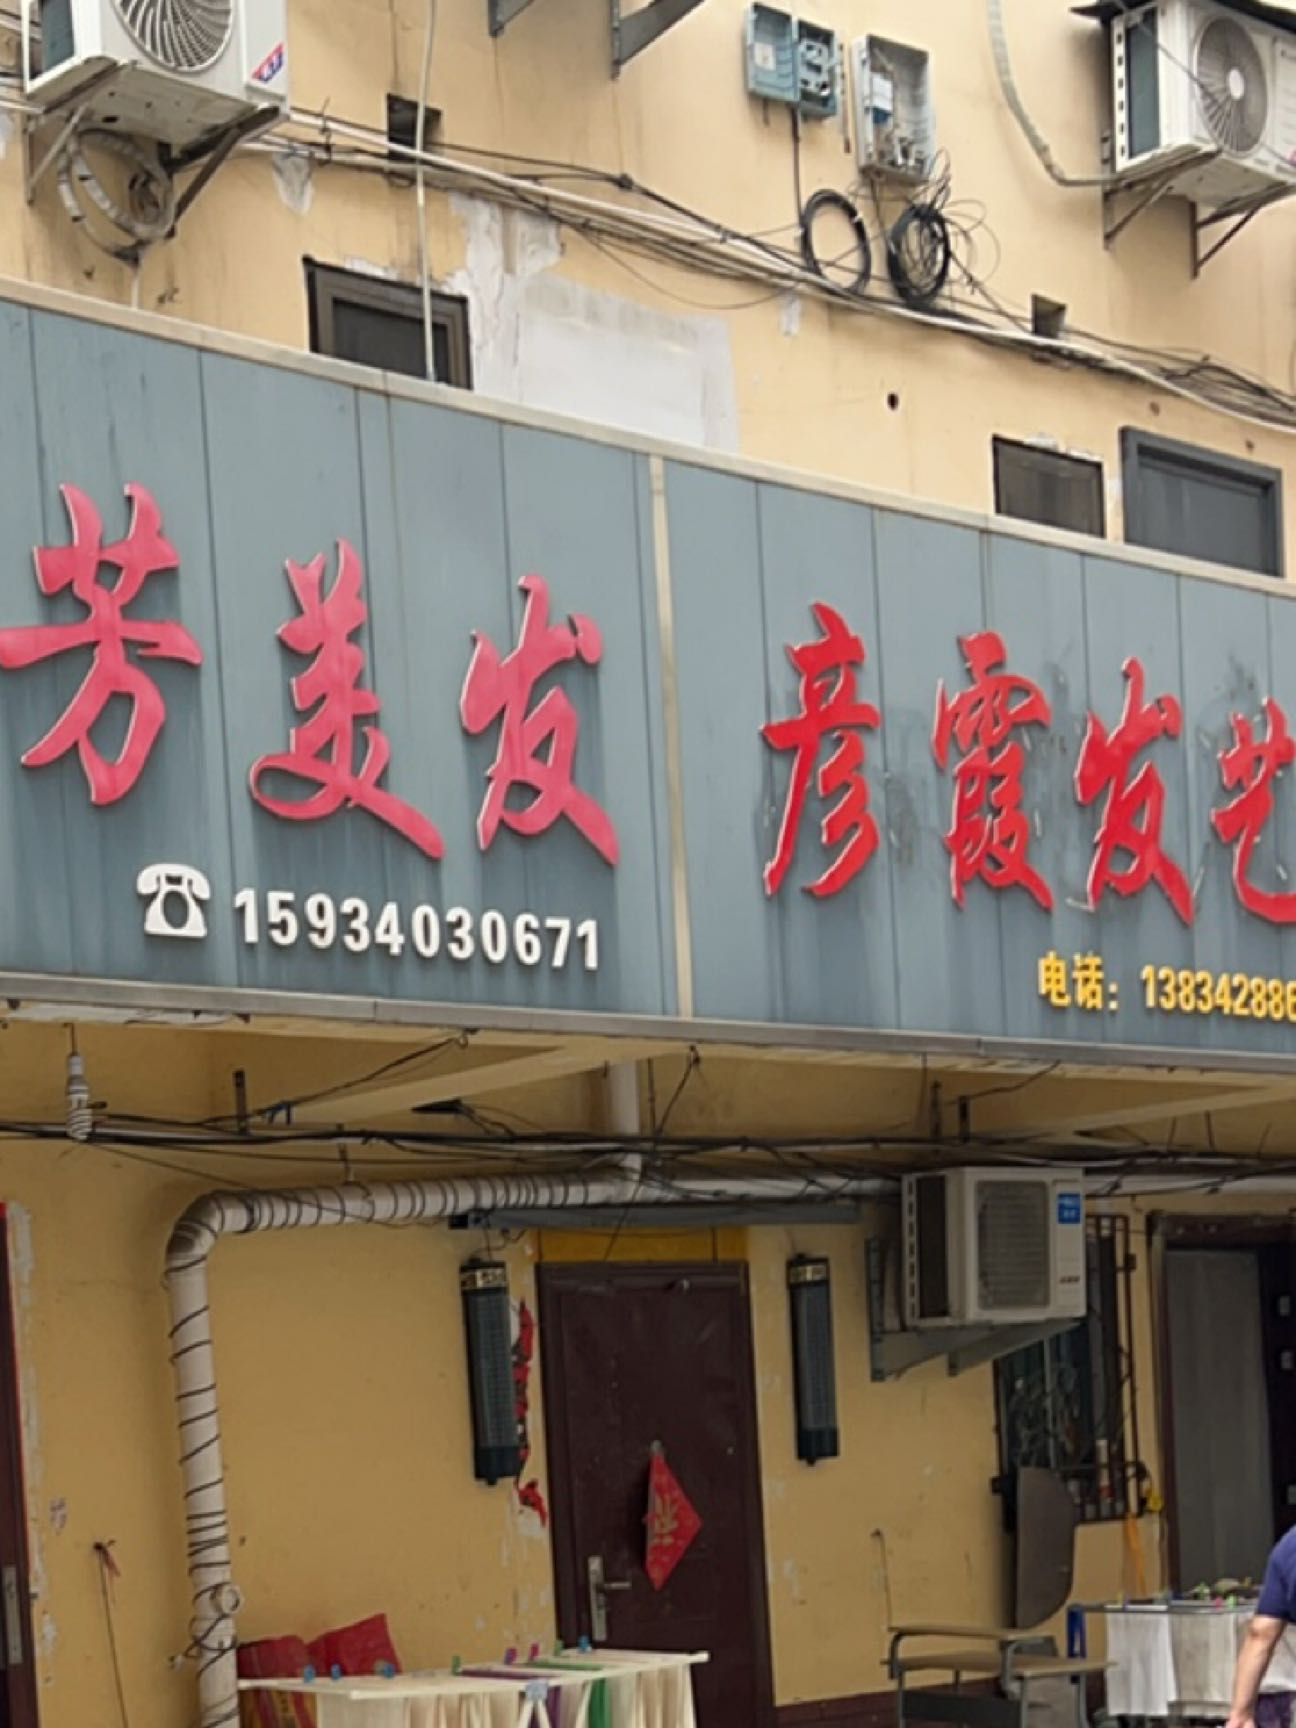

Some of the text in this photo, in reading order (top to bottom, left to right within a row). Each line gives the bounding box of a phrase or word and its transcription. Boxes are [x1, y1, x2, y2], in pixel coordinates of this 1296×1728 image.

[760, 602, 1296, 925] 彦霞发艺
[233, 886, 600, 970] 15934030671
